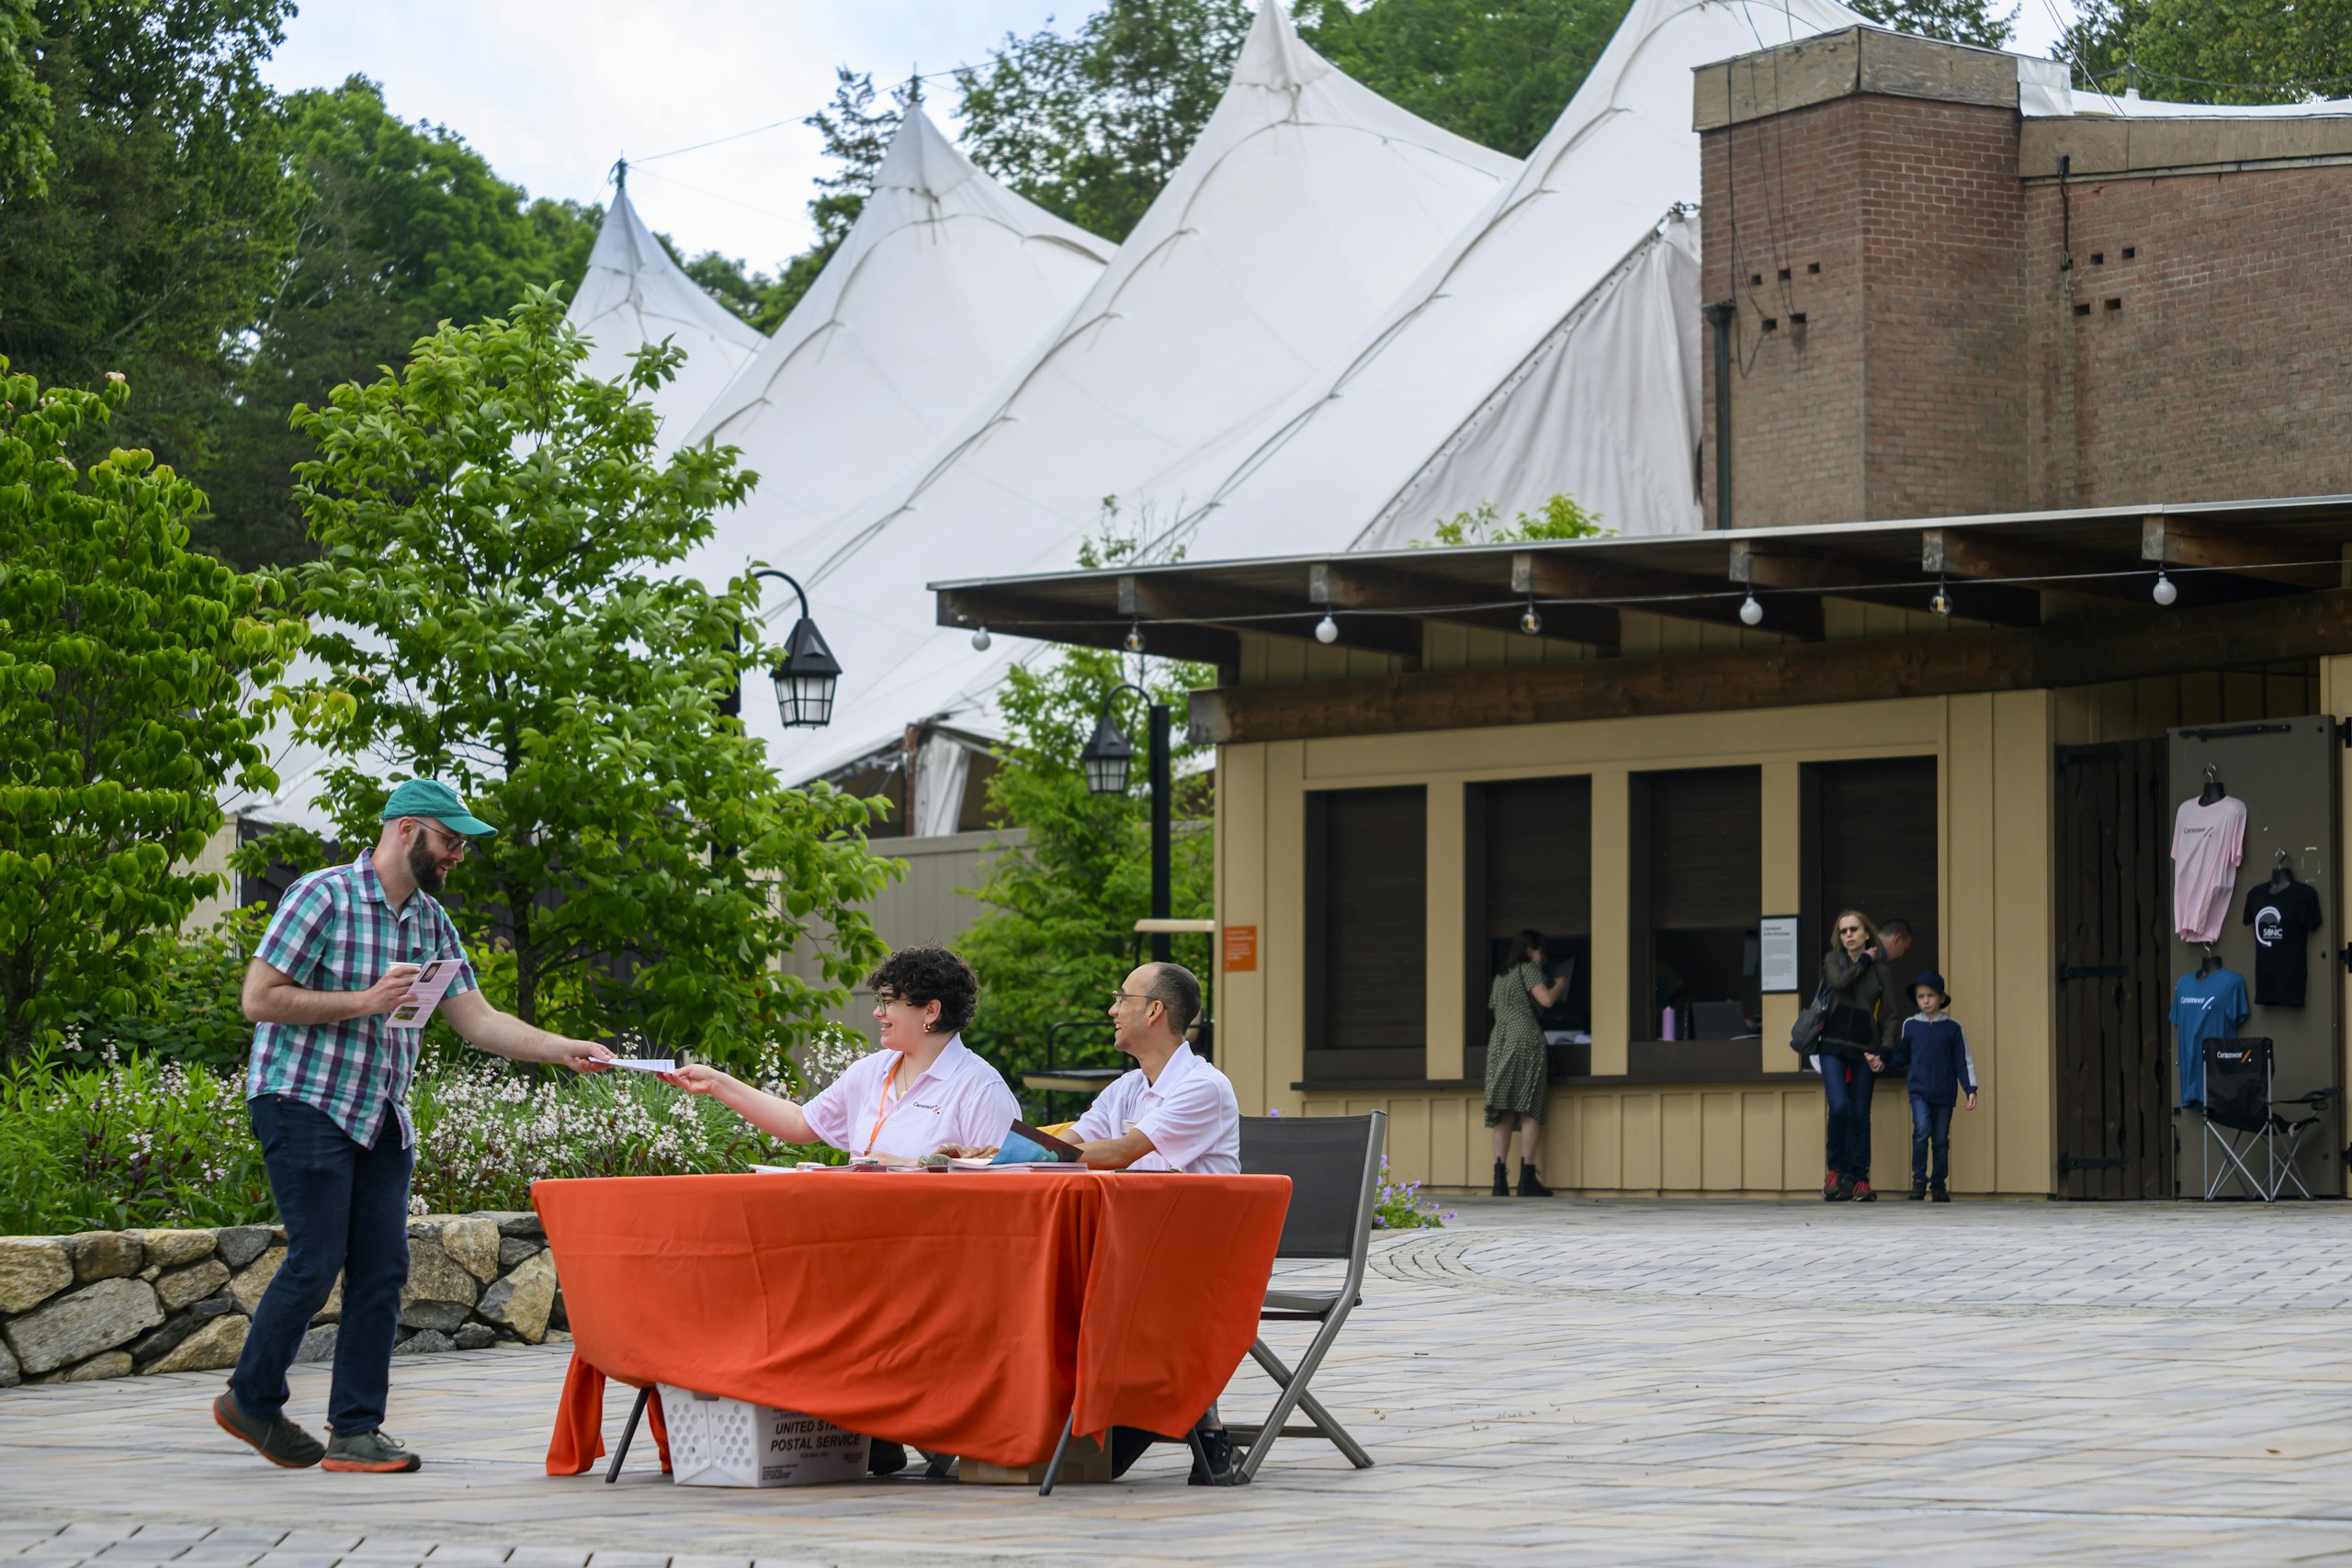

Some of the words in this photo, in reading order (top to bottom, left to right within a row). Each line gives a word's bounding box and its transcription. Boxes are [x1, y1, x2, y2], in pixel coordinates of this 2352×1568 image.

[2180, 996, 2205, 1004] Caramoor
[2216, 1050, 2243, 1058] Caramoor
[776, 1421, 814, 1435] UNITED
[818, 1420, 842, 1431] STA
[771, 1438, 812, 1451] POSTAL
[817, 1434, 860, 1448] SERVICE
